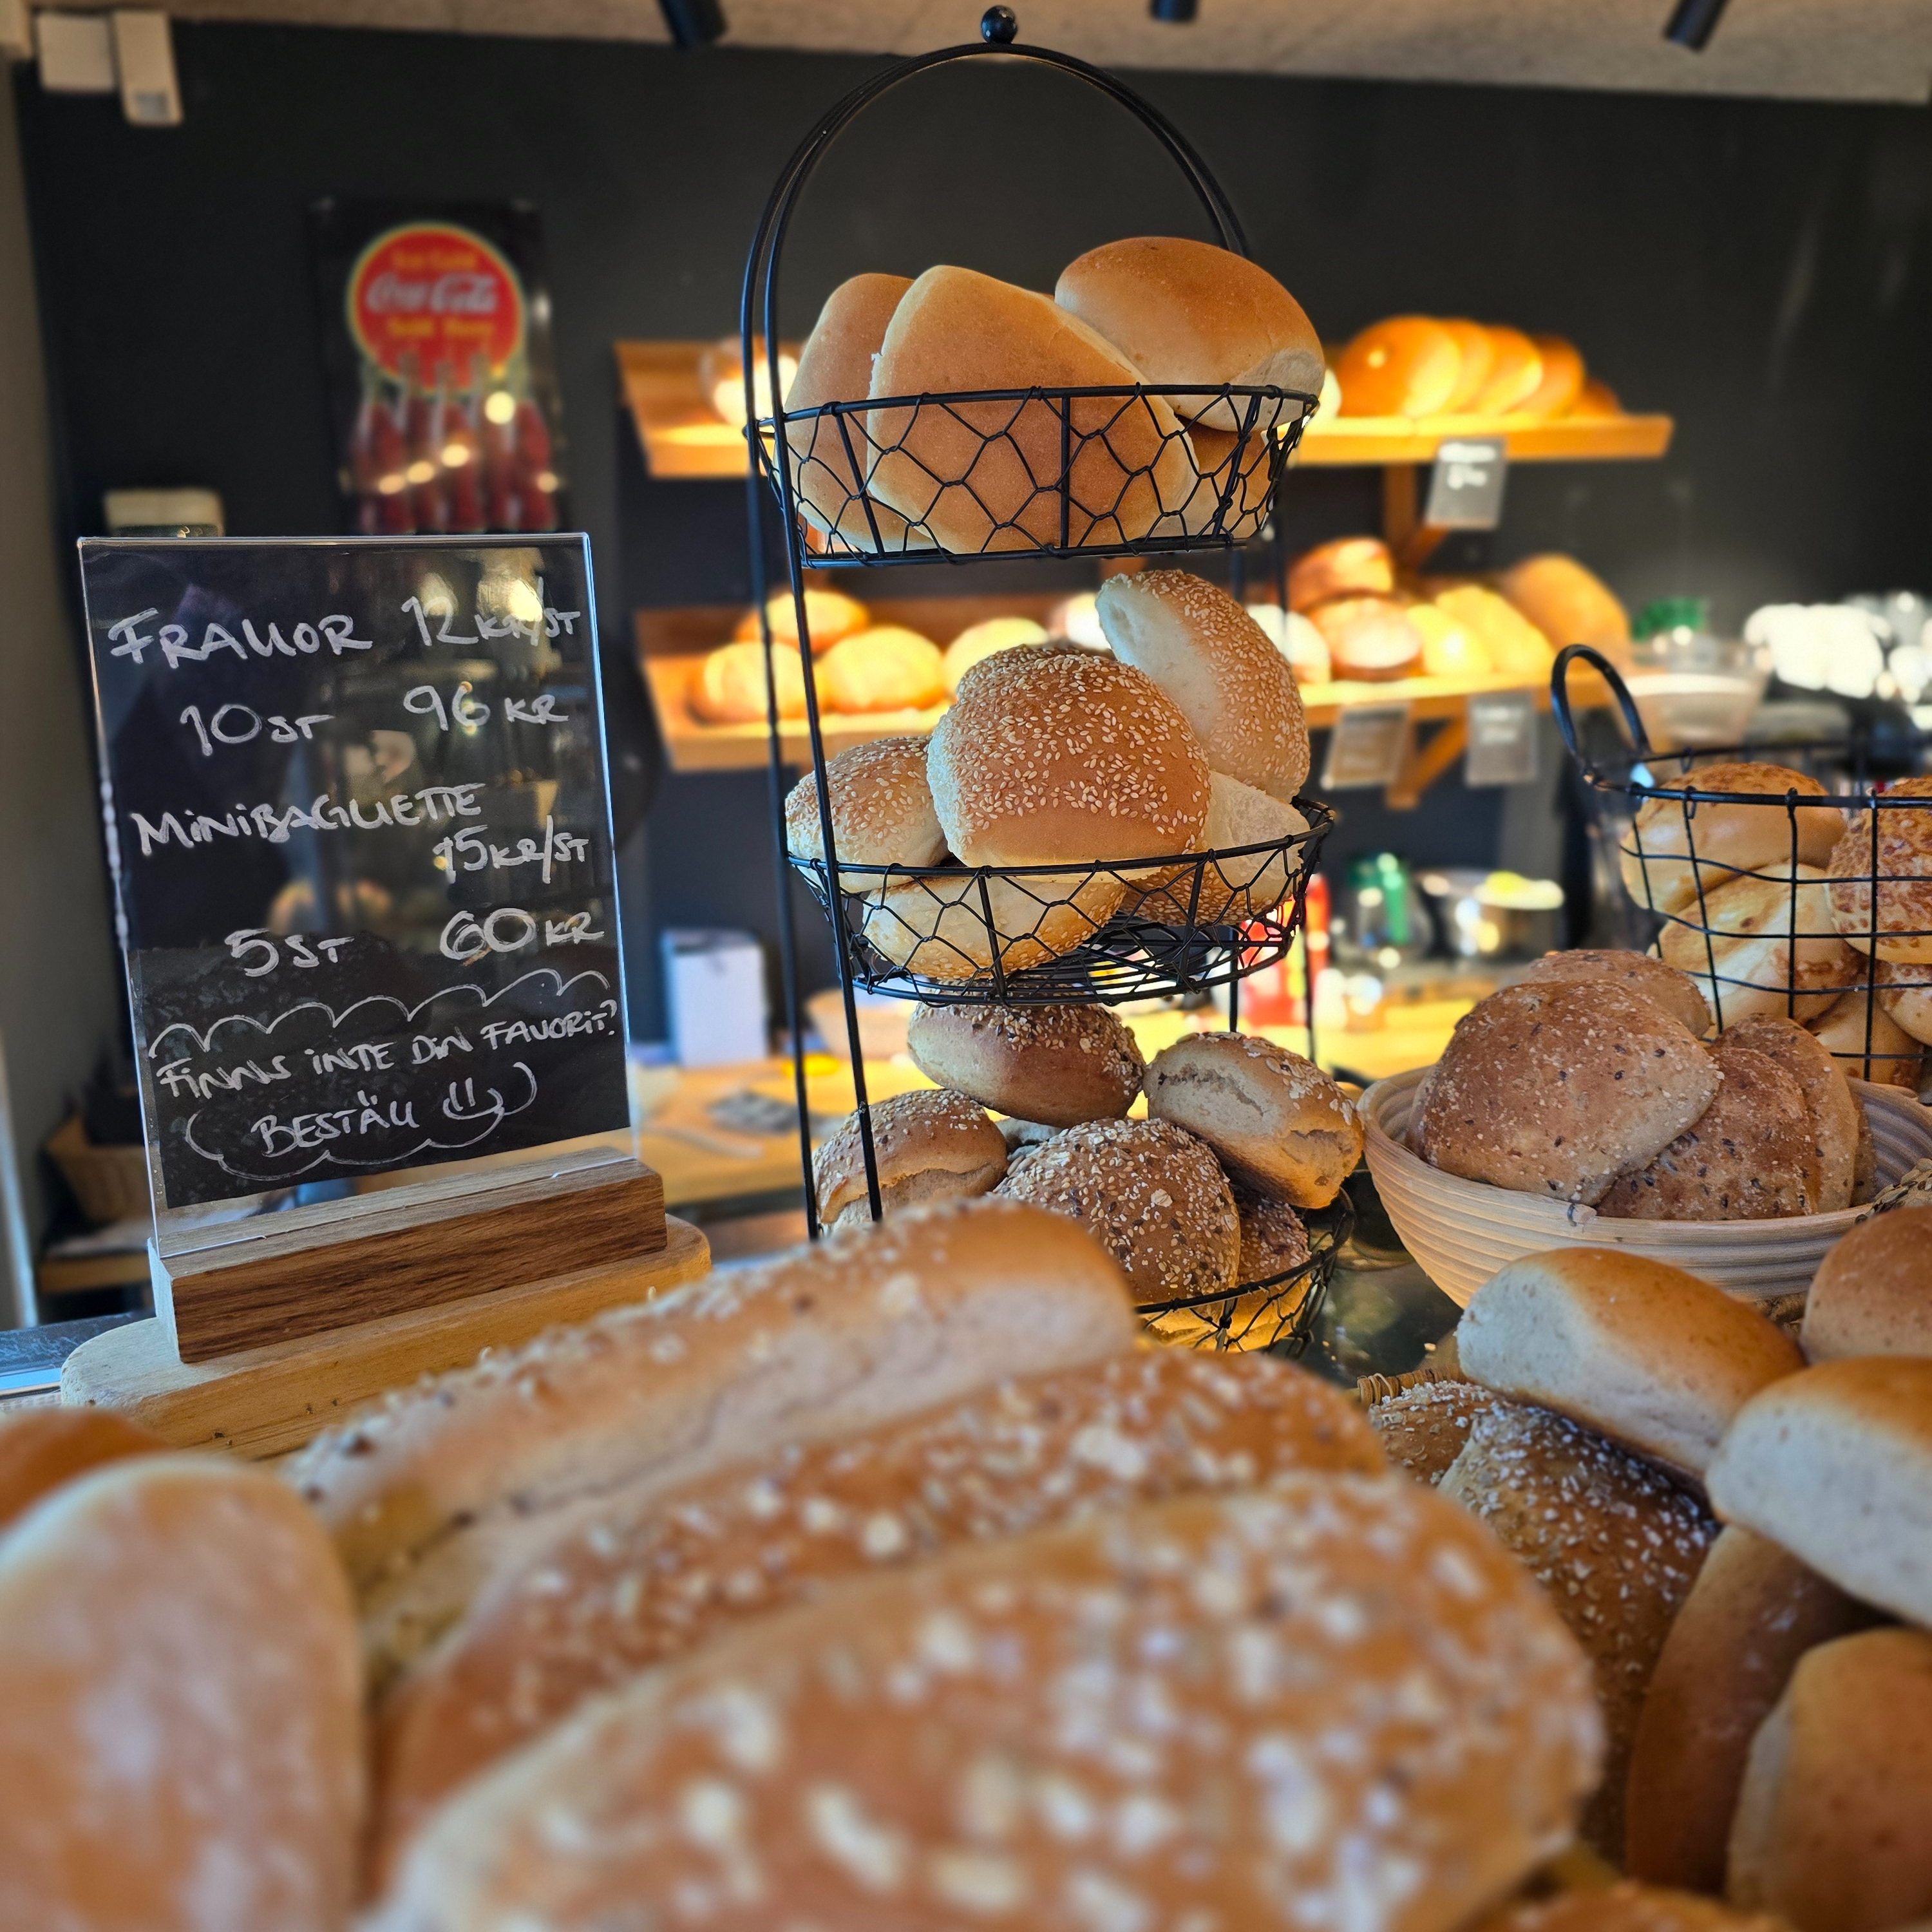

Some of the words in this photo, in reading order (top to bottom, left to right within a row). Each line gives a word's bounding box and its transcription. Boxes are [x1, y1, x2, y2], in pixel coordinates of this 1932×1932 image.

[401, 596, 479, 647] 12
[403, 681, 491, 732] 96
[439, 907, 538, 961] 60
